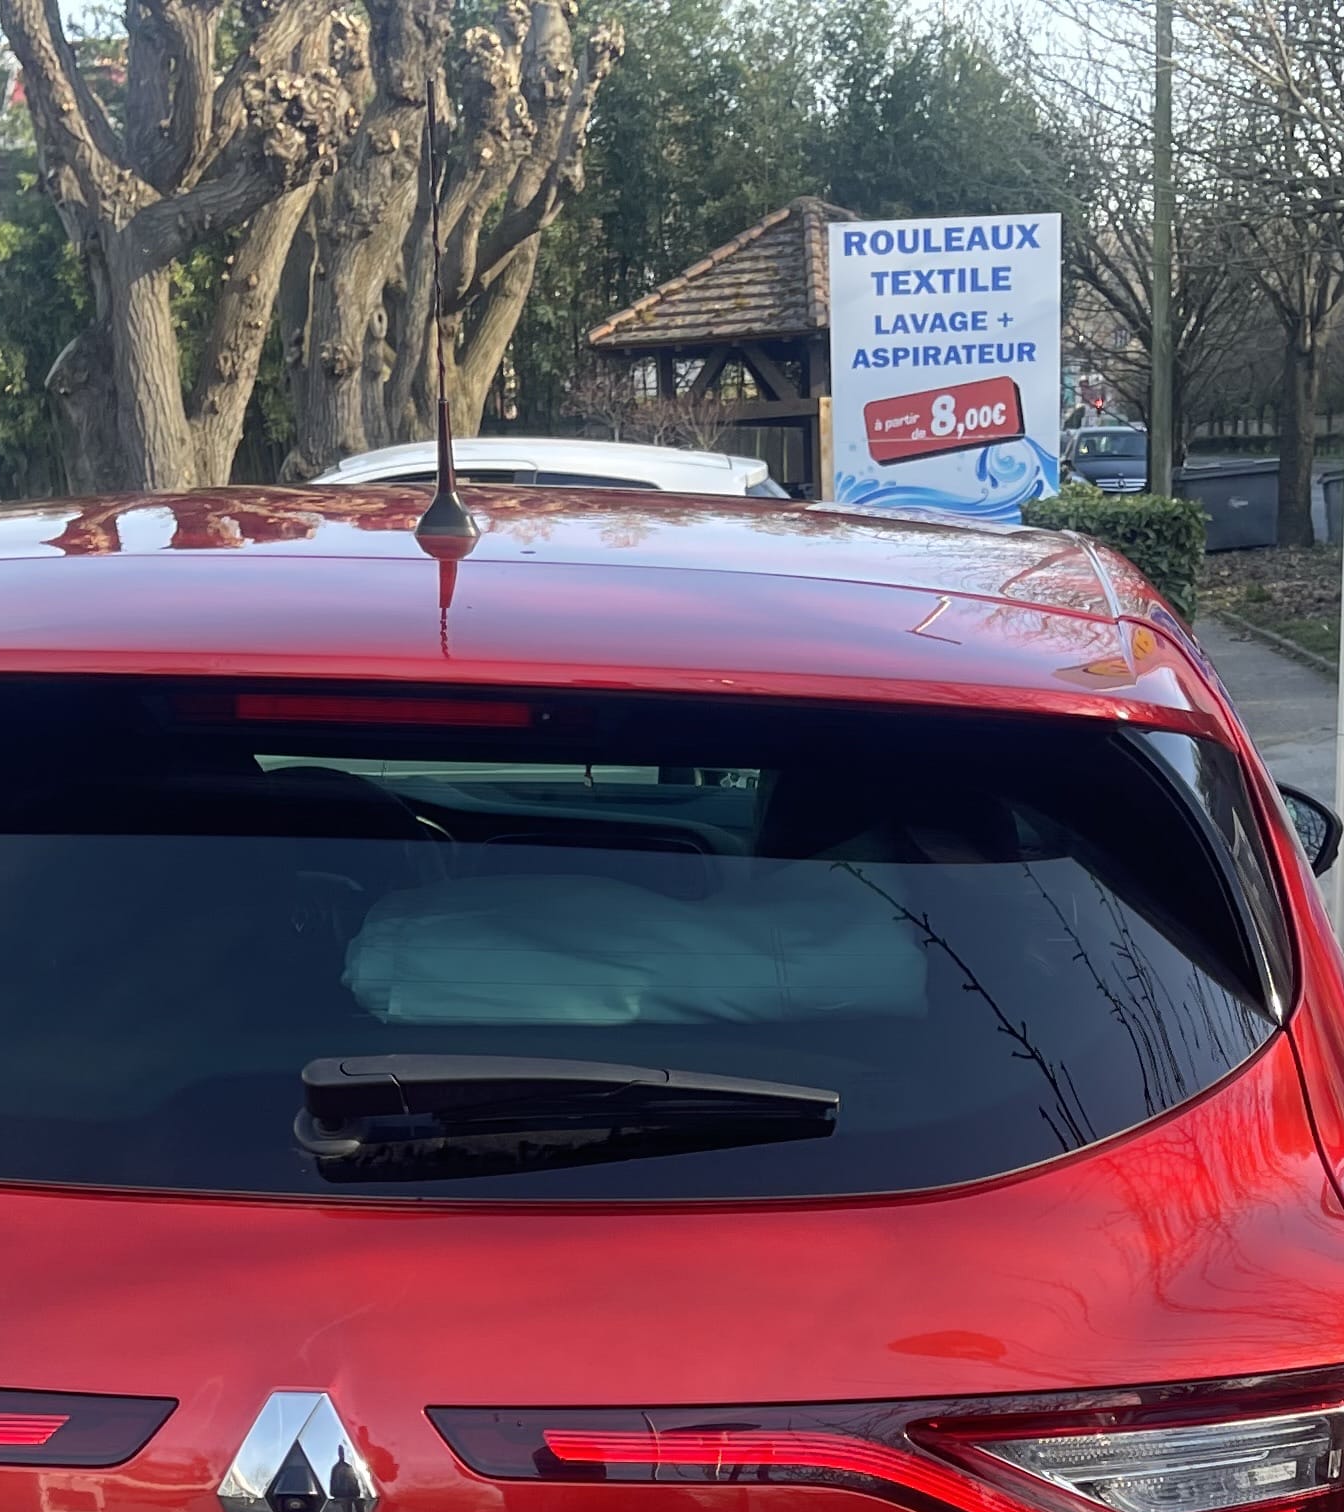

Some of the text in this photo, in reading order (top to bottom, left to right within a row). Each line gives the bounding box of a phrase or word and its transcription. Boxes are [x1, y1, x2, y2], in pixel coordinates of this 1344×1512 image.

[843, 223, 1041, 257] ROULEAUX
[870, 266, 1013, 297] TEXTILE
[874, 311, 1014, 335] LAVAGE +
[852, 342, 1037, 369] ASPIRATEUR
[874, 394, 1006, 440] à partir 8,00€
[911, 427, 927, 440] de
